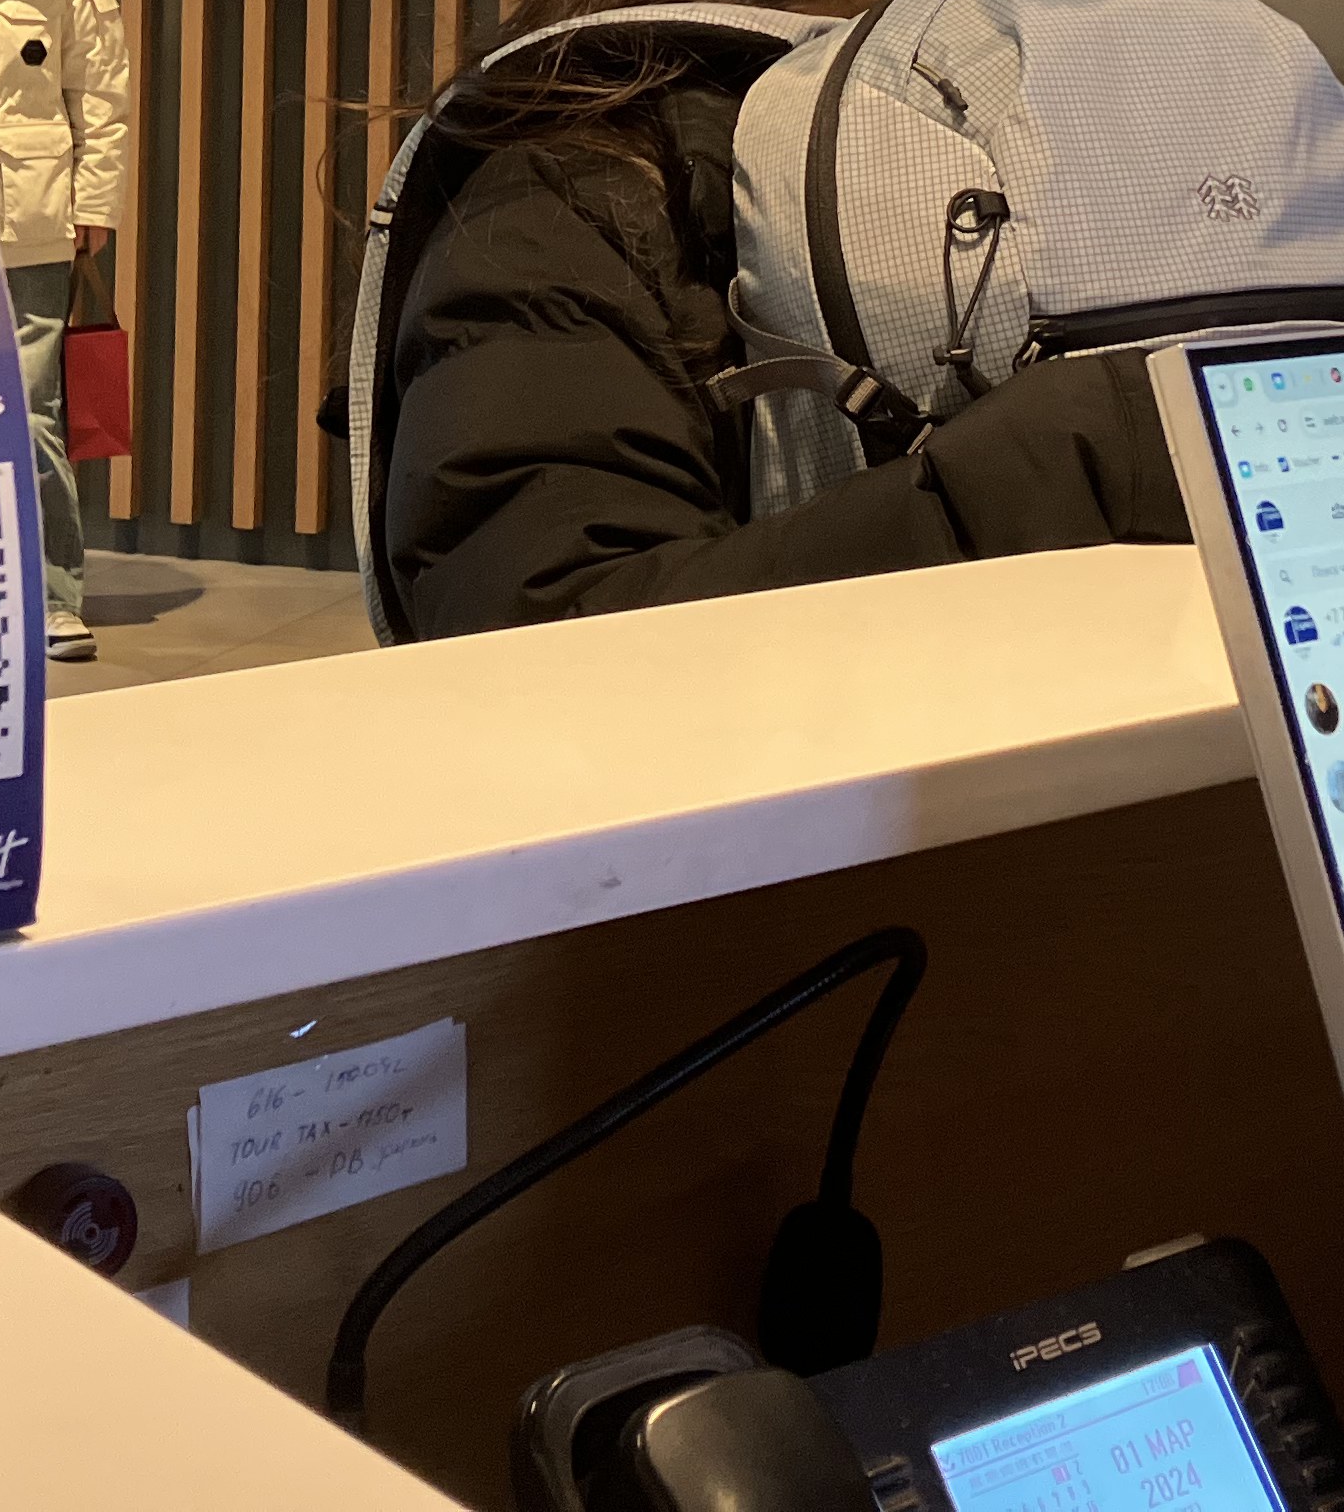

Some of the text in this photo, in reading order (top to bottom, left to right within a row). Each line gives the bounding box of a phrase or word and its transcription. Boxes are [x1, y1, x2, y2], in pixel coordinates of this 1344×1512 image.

[297, 1120, 332, 1145] TAX
[1008, 1320, 1103, 1373] iPECS
[991, 1420, 1056, 1454] Reception
[1110, 1440, 1143, 1474] 01
[1140, 1458, 1204, 1509] 2024
